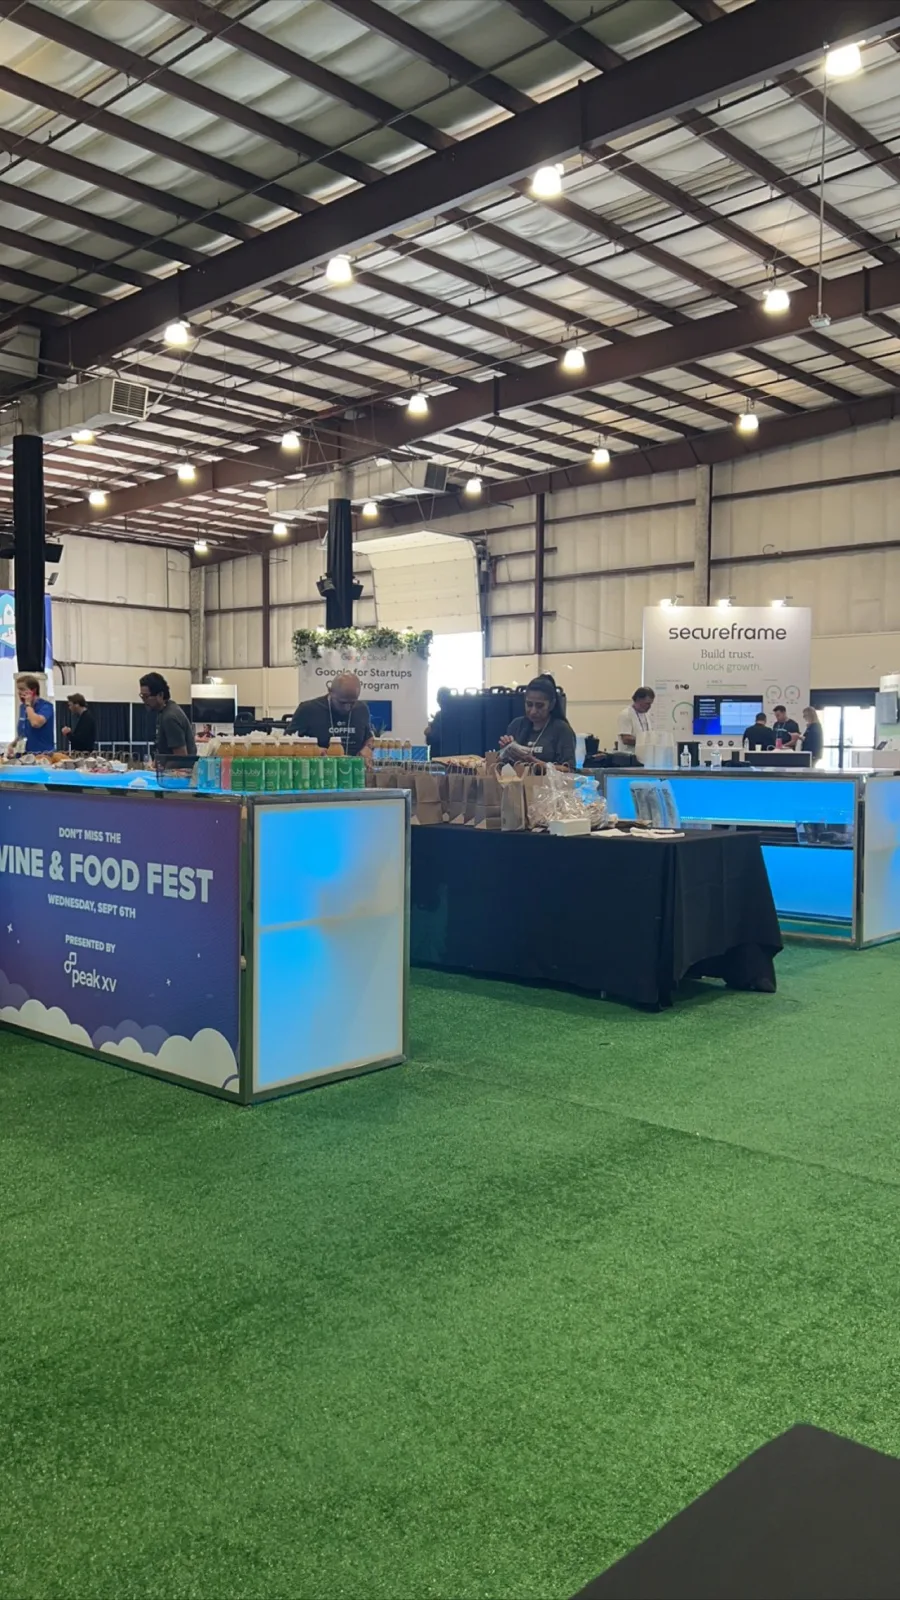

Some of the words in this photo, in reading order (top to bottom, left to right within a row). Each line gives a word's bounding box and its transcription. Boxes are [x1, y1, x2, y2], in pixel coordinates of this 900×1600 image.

[668, 623, 787, 640] secureframe
[700, 649, 725, 659] Build
[729, 649, 755, 659] trust.
[354, 667, 368, 677] for
[370, 668, 412, 679] Startups
[692, 662, 724, 671] Unlock
[726, 662, 762, 673] growth.
[59, 827, 83, 840] DON'T
[84, 829, 103, 842] MISS
[105, 831, 121, 844] THE
[49, 850, 64, 881] &
[70, 853, 140, 891] FOOD
[147, 862, 214, 903] FEST
[47, 893, 96, 914] WEDNESDAY,
[97, 902, 118, 916] SEPT
[119, 905, 136, 919] 6TH
[65, 934, 104, 951] PRESENTED
[105, 942, 116, 954] BY
[72, 968, 101, 988] peak
